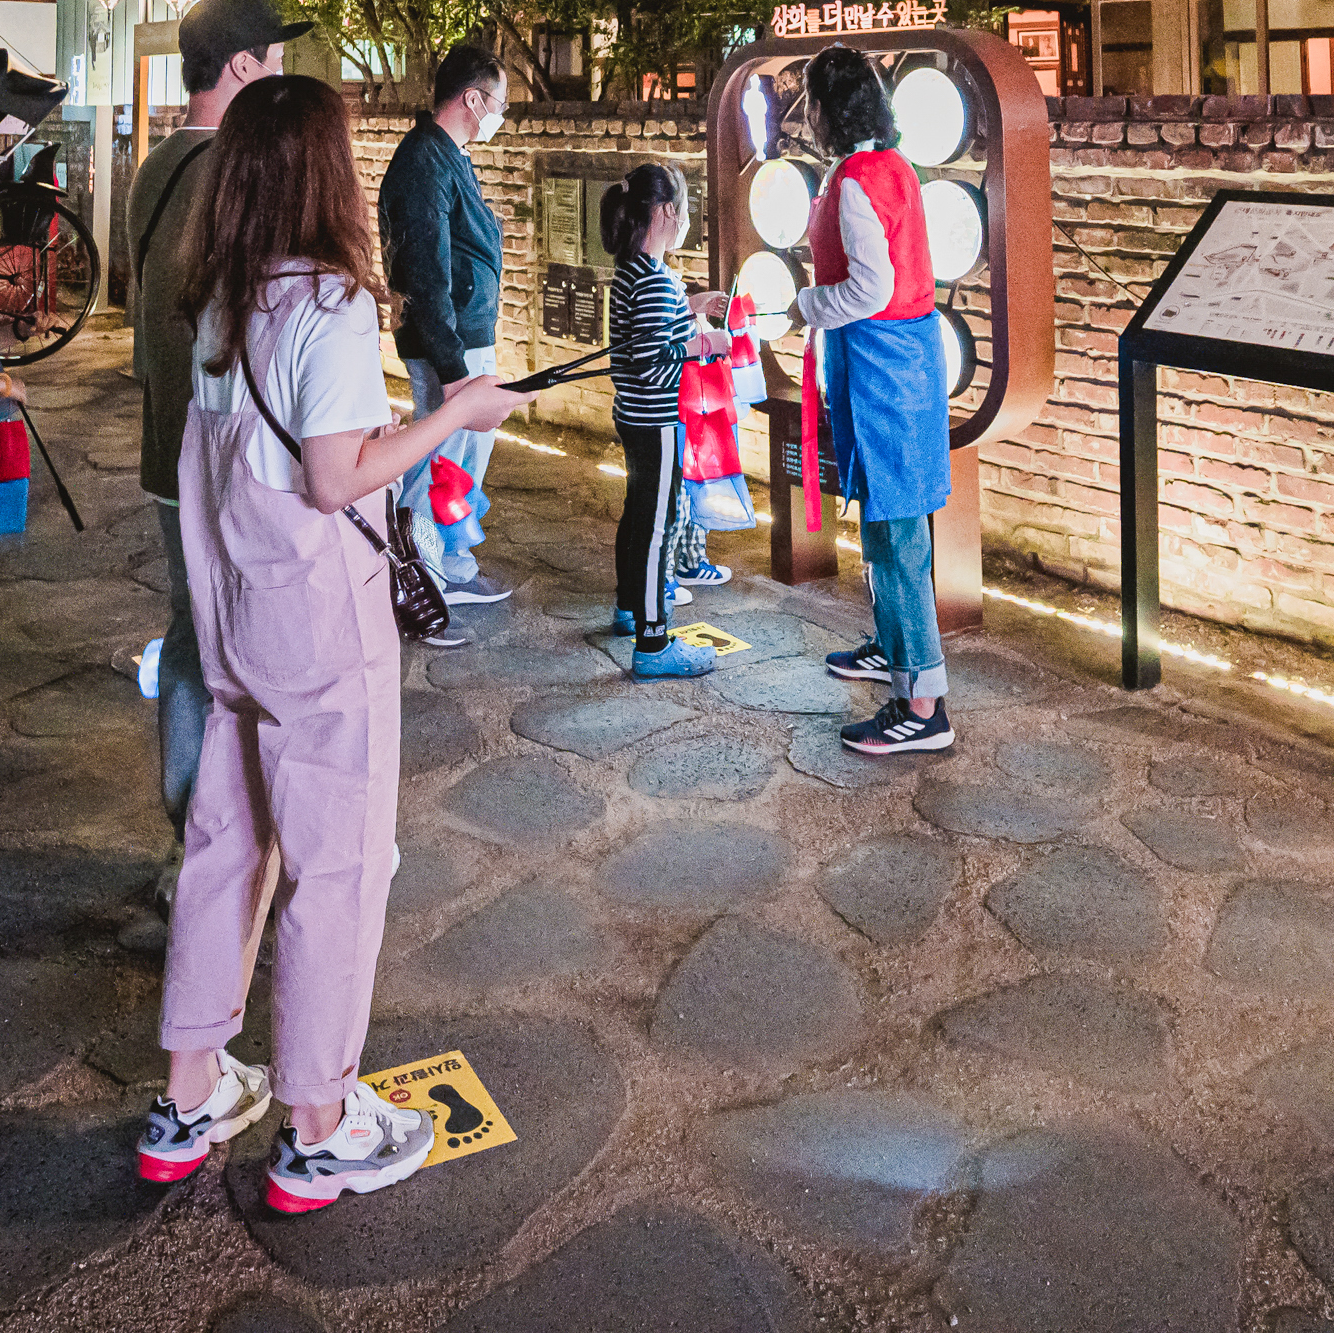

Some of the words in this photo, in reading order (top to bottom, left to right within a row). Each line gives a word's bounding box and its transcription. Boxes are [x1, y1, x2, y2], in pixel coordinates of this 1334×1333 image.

[770, 2, 822, 37] 상화를
[823, 0, 843, 32] 더
[844, 2, 876, 30] 만날
[876, 2, 894, 28] 수
[896, 0, 929, 27] 있는
[392, 1058, 463, 1087] 앞사람과
[393, 1092, 409, 1101] OK
